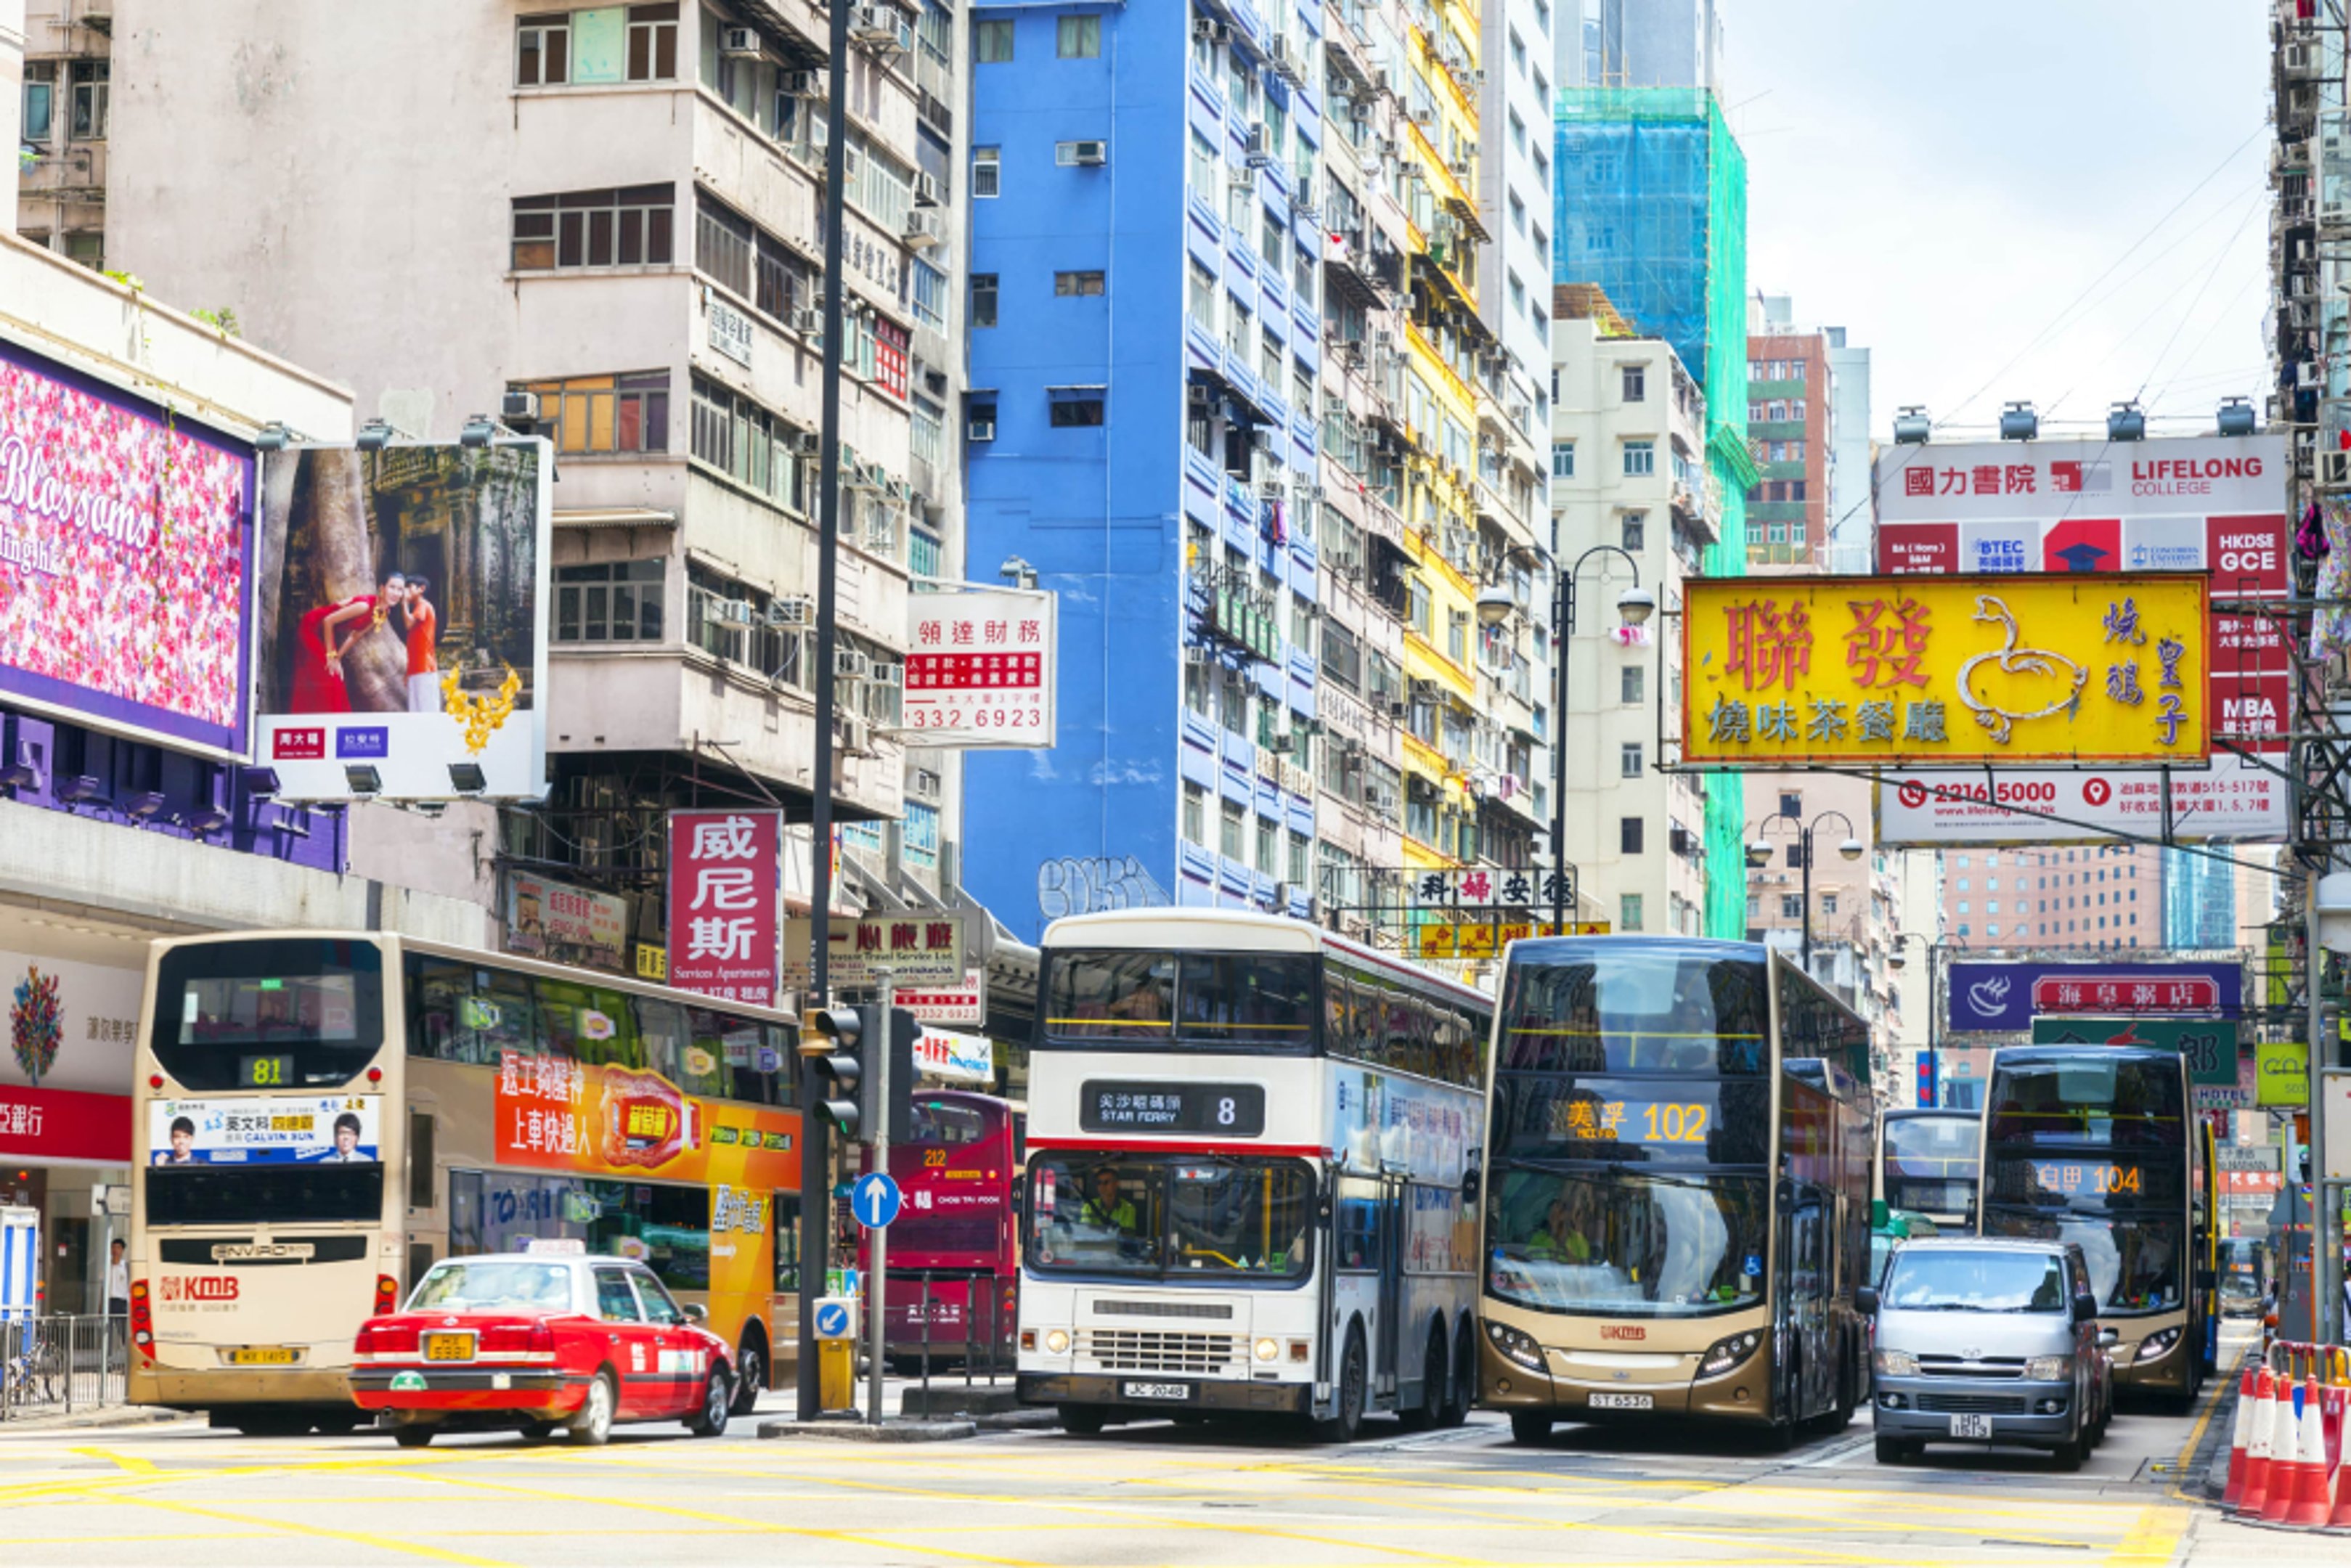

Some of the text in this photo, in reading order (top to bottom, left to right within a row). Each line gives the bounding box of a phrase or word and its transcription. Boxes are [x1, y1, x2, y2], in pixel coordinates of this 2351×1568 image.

[1905, 464, 2036, 497] 國力書院
[2132, 457, 2263, 481] LIFELONG
[0, 435, 147, 550] Blossoms
[2132, 481, 2212, 497] COLLEGE
[1980, 540, 2025, 554] BTEC
[2219, 533, 2275, 550] HKDSE
[2220, 551, 2277, 572] GCE
[918, 620, 1040, 645] 領達財務
[1723, 597, 1934, 692] 聯發
[2156, 637, 2190, 746] 皇子
[905, 709, 1041, 727] 332 6923
[2223, 698, 2277, 719] MBA
[1706, 698, 1950, 743] 燒味茶餐廳
[1934, 781, 2056, 804] 2216 5000
[688, 814, 759, 961] 威尼斯
[864, 950, 895, 962] Travel
[896, 951, 932, 962] Service
[675, 965, 771, 983] Services Apartments
[253, 1058, 282, 1085] 81
[2199, 1089, 2249, 1101] HOTEL
[1101, 1111, 1177, 1123] STAR FERRY
[1218, 1097, 1236, 1125] 8
[1643, 1103, 1707, 1142] 102
[924, 1149, 946, 1167] 212
[2094, 1165, 2140, 1194] 104
[184, 1276, 240, 1301] KMB
[1593, 1395, 1611, 1408] ST
